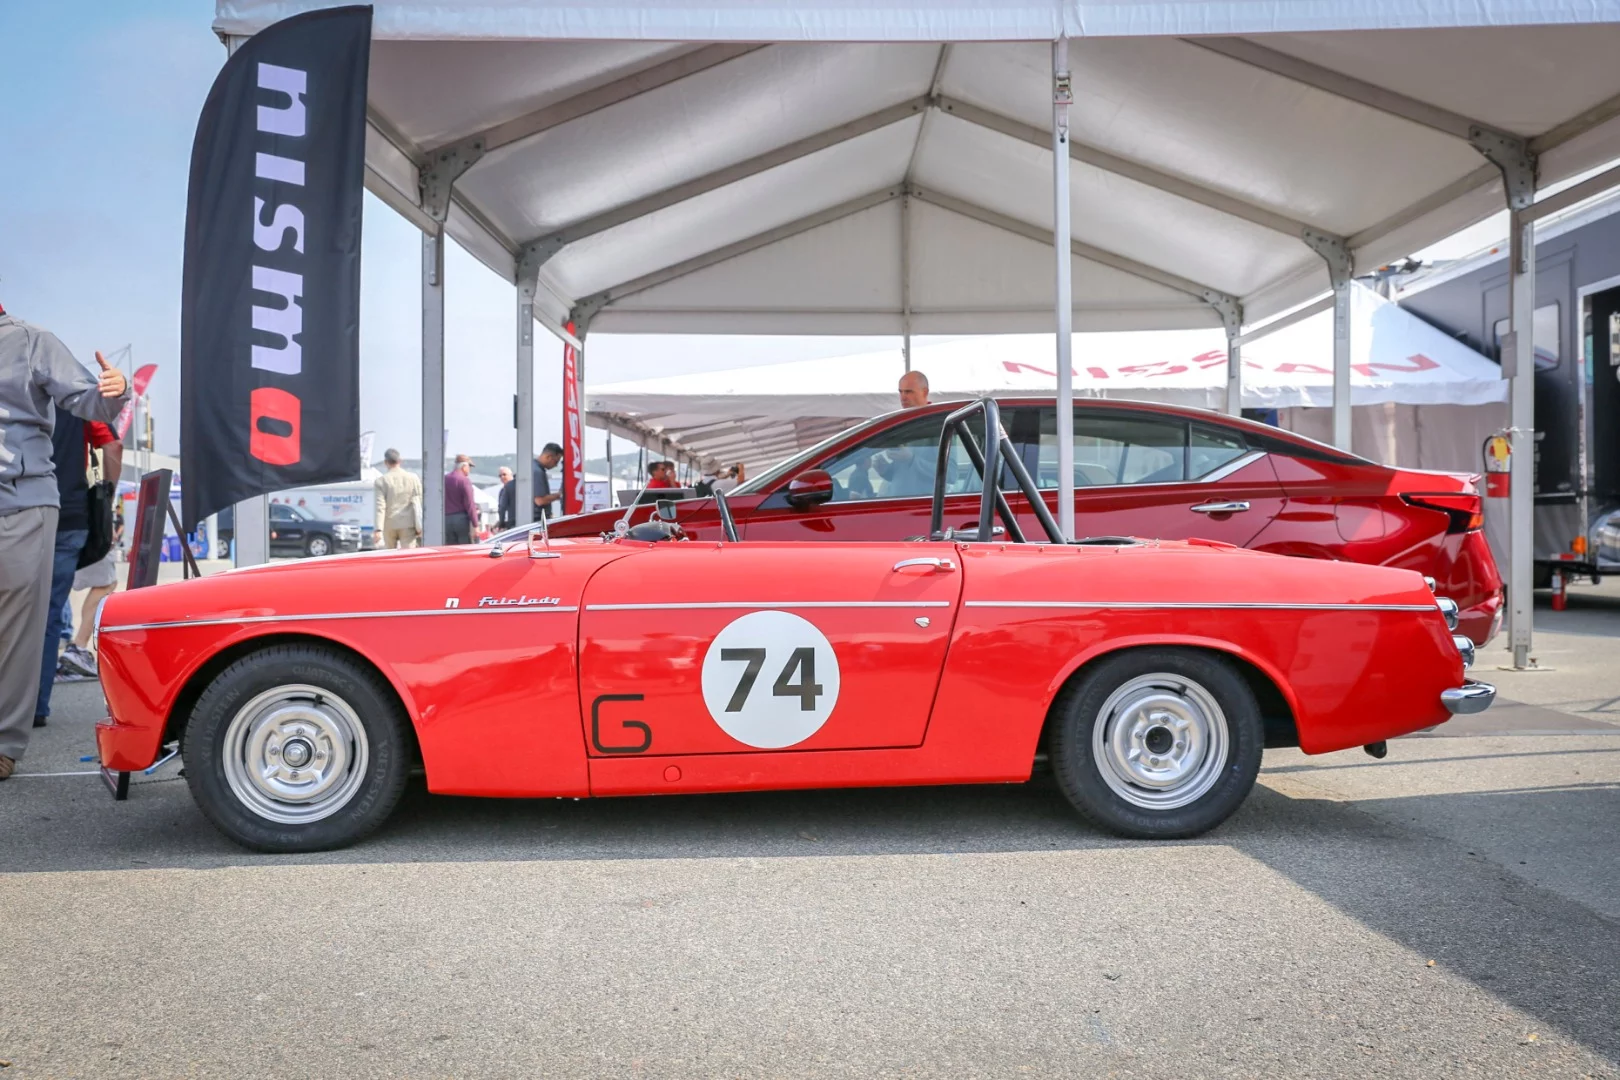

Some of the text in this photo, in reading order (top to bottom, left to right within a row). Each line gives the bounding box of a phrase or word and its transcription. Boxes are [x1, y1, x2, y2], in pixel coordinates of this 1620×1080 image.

[1002, 349, 1441, 379] NISSAN
[720, 646, 823, 713] 74
[591, 693, 653, 754] G
